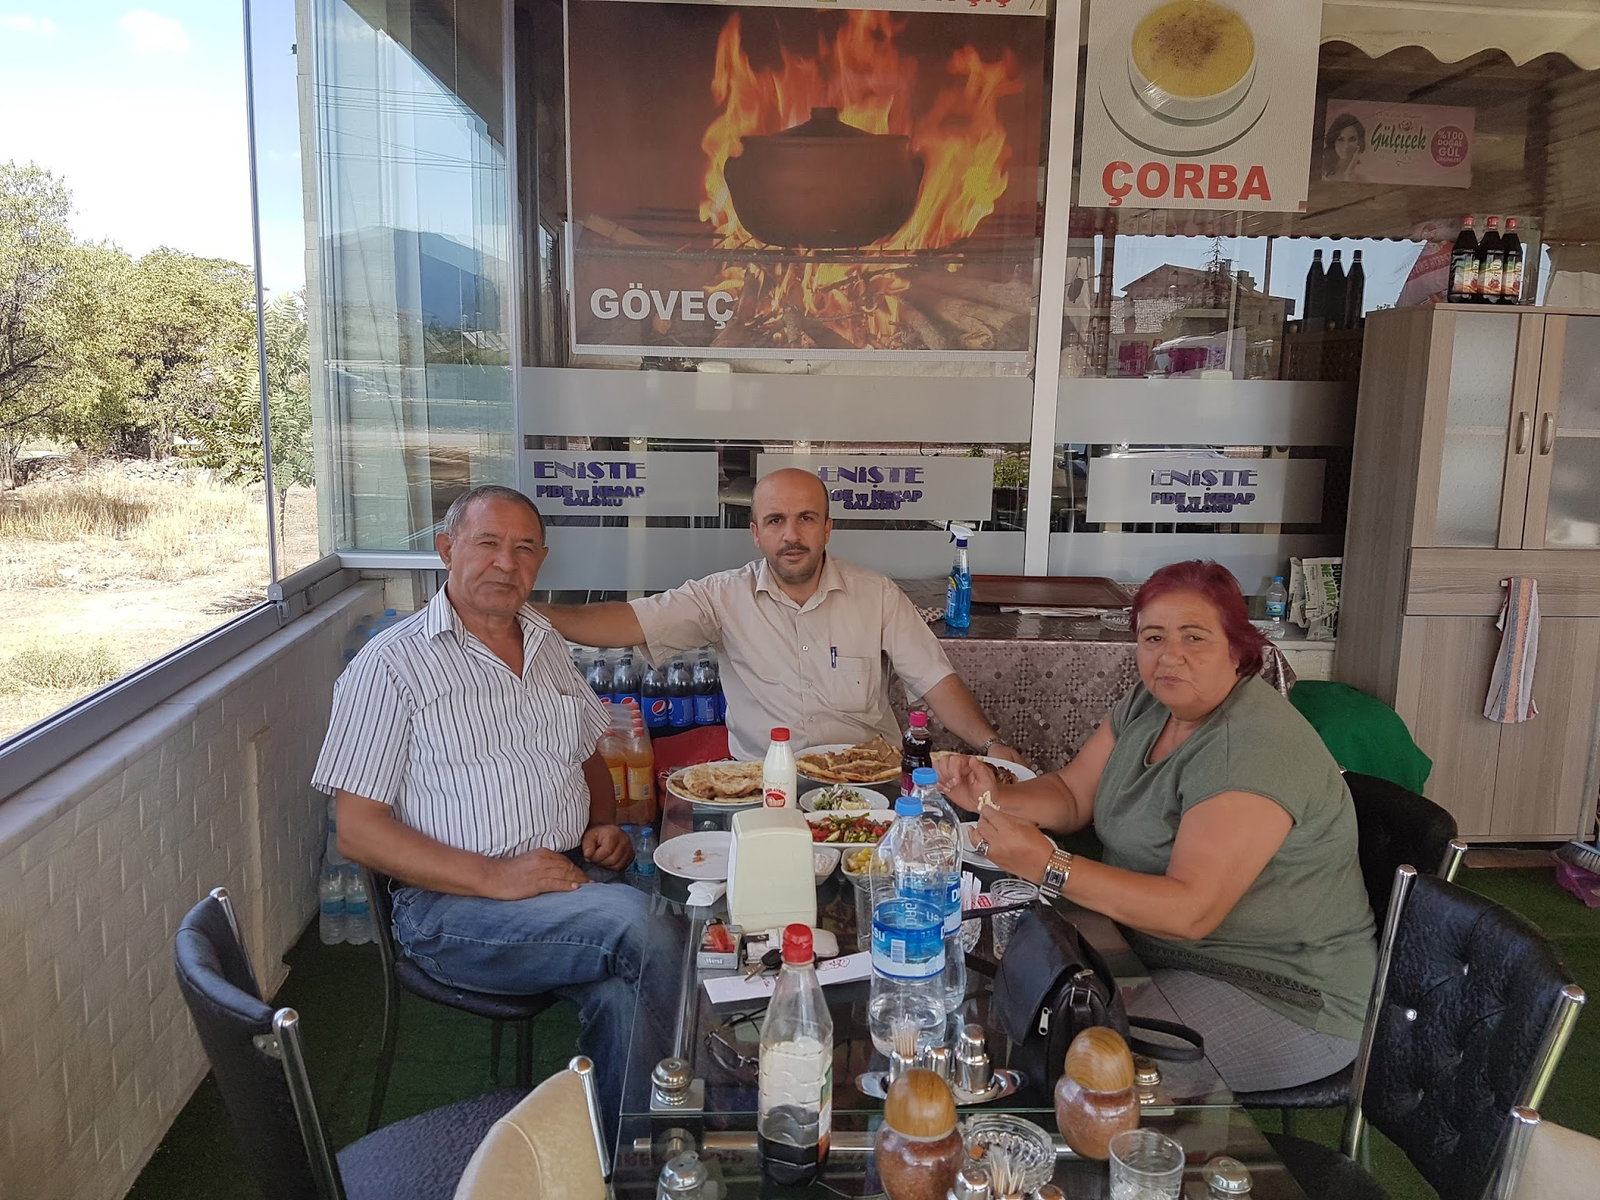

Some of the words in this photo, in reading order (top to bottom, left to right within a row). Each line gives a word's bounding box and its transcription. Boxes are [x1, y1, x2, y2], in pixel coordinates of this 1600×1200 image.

[1438, 146, 1460, 157] GÜL
[1102, 160, 1272, 207] ÇORBA
[590, 282, 734, 330] GÖVEÇ
[563, 497, 623, 507] SALONU
[1204, 493, 1256, 505] KEBAP
[1176, 503, 1233, 513] SALONU
[705, 957, 723, 965] West
